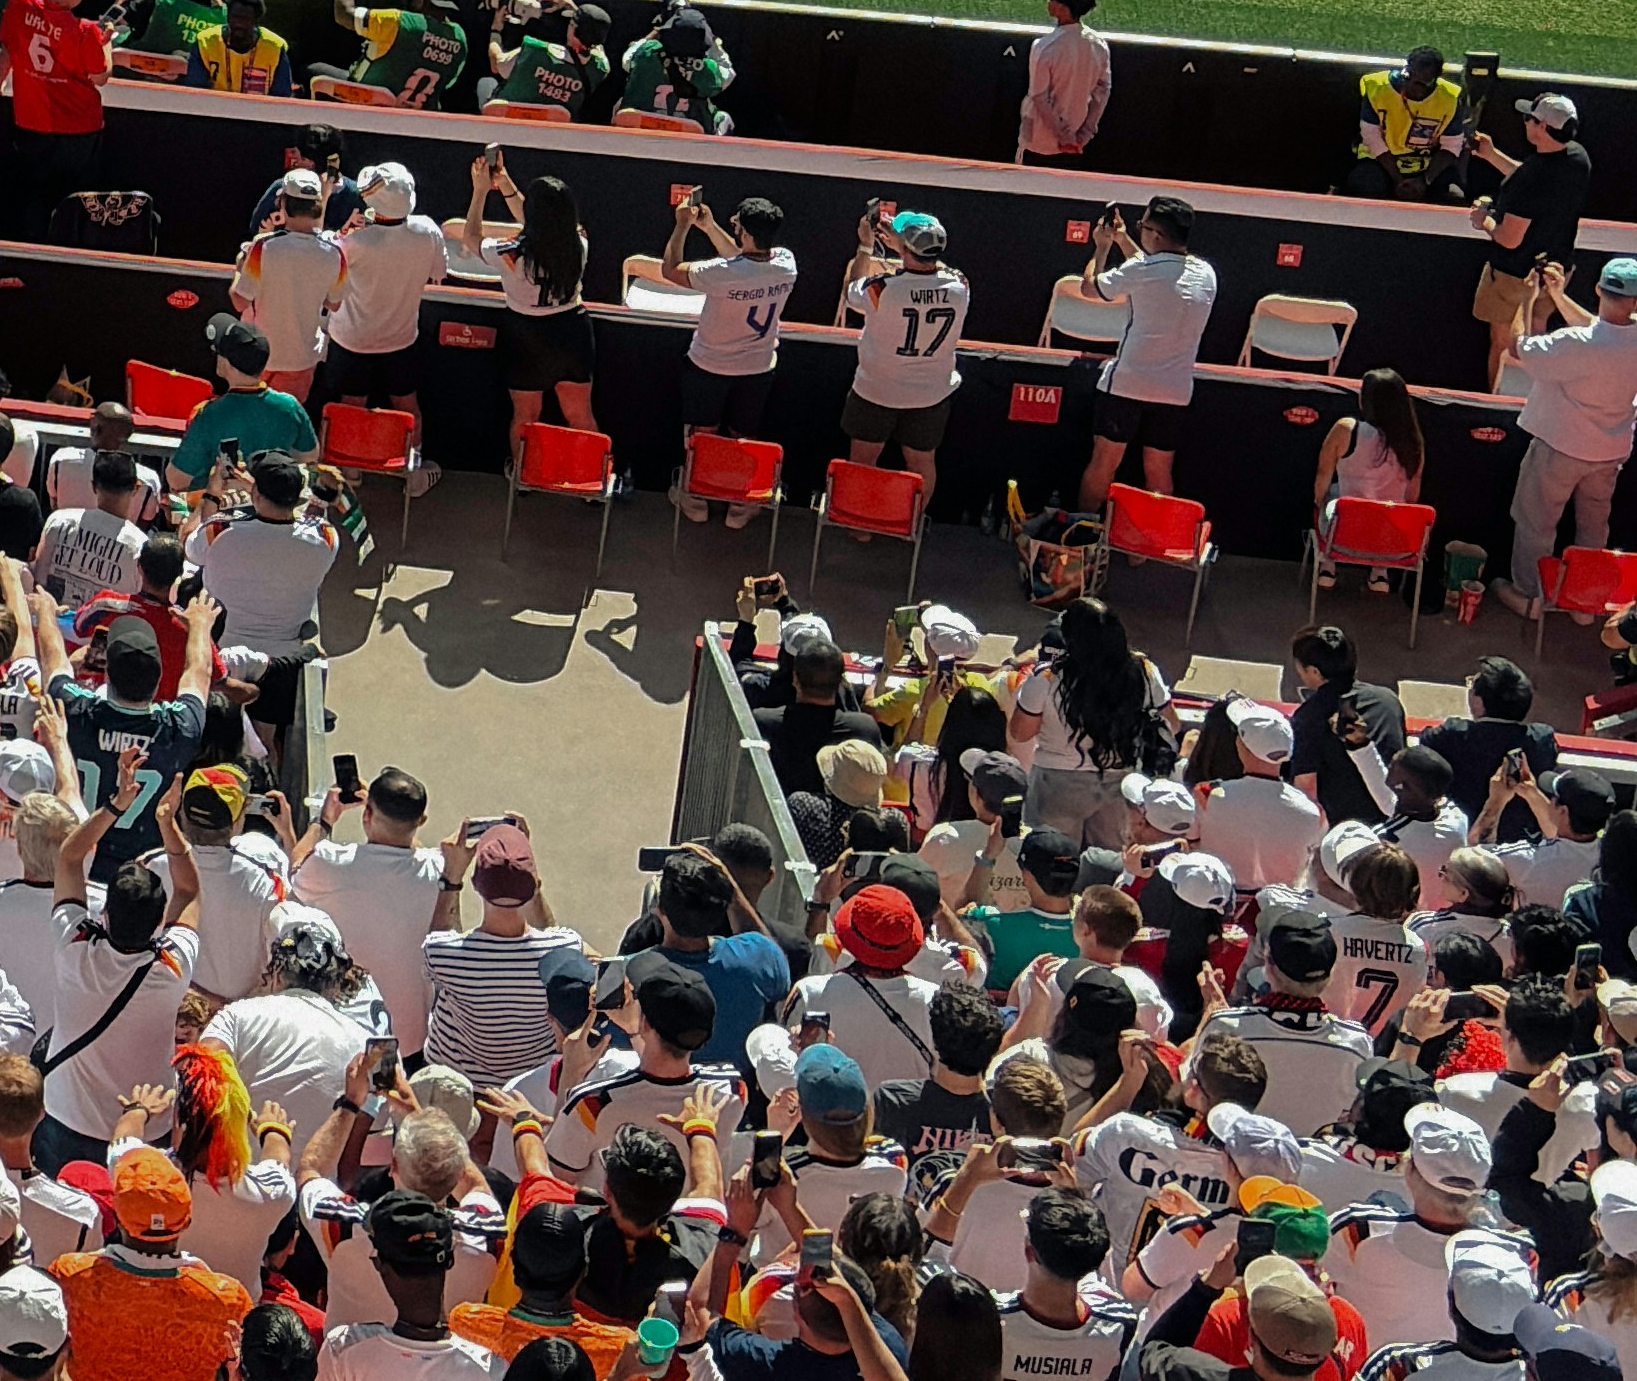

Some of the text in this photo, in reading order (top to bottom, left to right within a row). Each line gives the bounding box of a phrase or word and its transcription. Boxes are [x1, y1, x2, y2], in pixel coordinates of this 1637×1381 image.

[27, 33, 55, 74] 6
[421, 30, 461, 54] PHOTO
[422, 47, 453, 65] 0699
[534, 66, 584, 92] PHOTO
[538, 83, 572, 103] 1483
[728, 290, 765, 302] SERGIO
[910, 289, 949, 303] WIRTZ
[746, 303, 777, 338] 4
[896, 307, 955, 358] 17
[1019, 385, 1057, 404] 110A
[77, 527, 126, 564] MIGHT
[80, 551, 123, 587] LOUD
[98, 728, 157, 757] WIRTZ
[1343, 937, 1413, 965] HAVERTZ
[1355, 966, 1404, 1027] 7
[1118, 1145, 1231, 1206] Germ
[1013, 1354, 1093, 1377] MUSIALA
